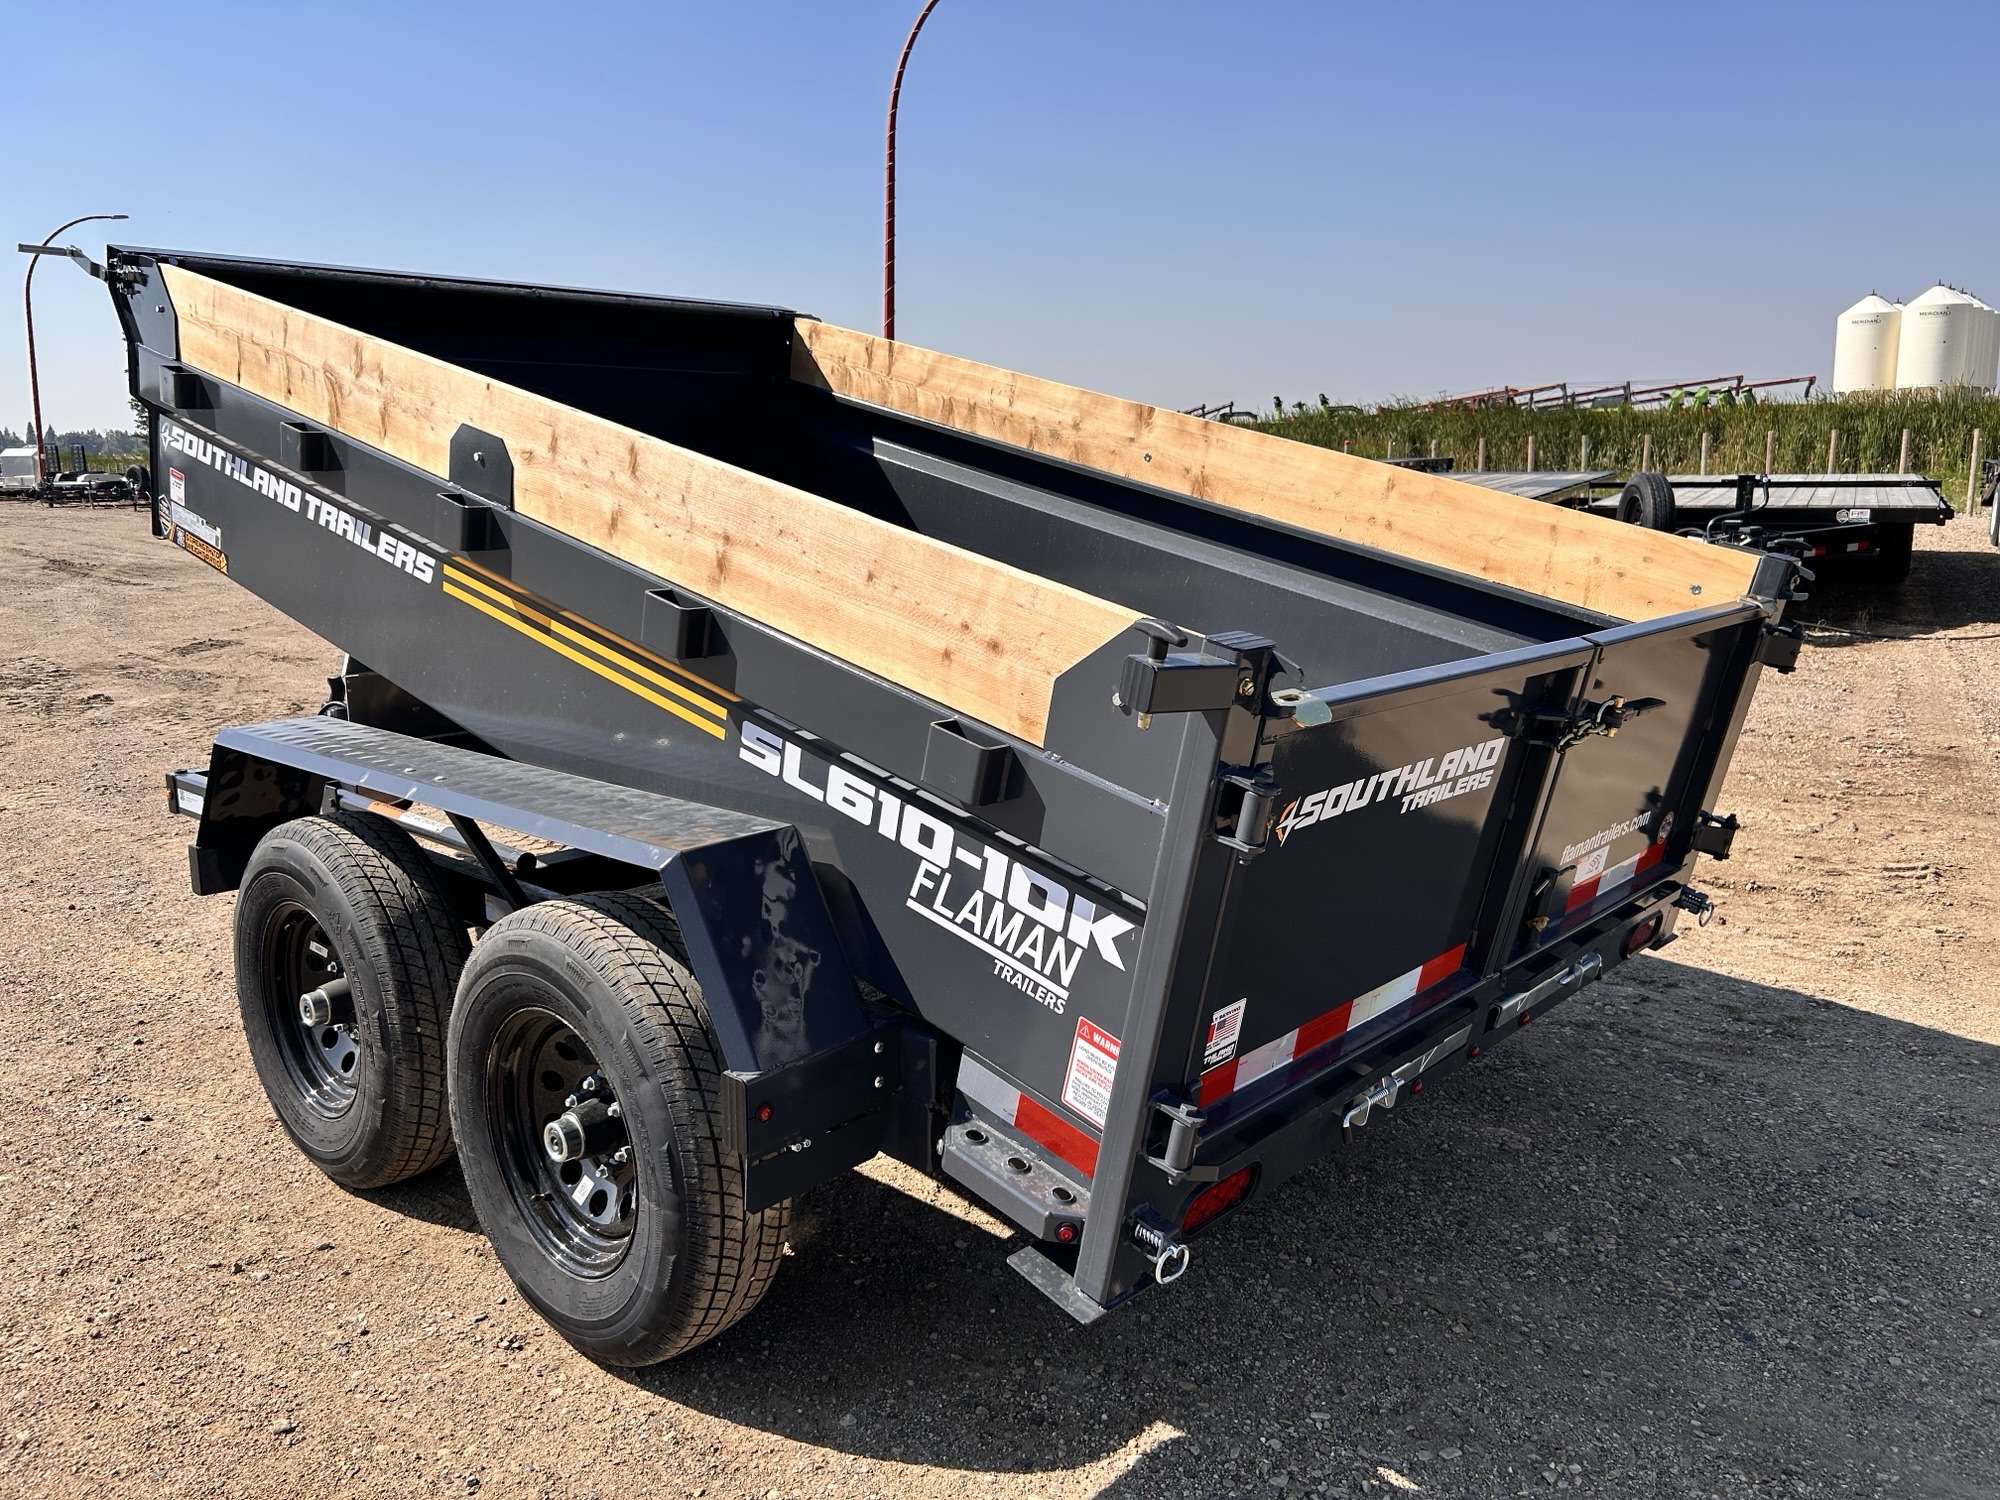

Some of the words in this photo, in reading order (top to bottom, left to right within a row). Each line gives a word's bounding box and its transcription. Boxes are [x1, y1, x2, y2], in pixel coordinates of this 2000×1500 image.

[169, 425, 301, 513] SOUTHLAND
[304, 492, 436, 584] TRAILERS
[1294, 737, 1506, 830] SOUTHLAND
[1400, 769, 1495, 815] TRAILERS
[739, 720, 1136, 972] SL610-10K
[1559, 810, 1652, 866] flamantrailers.com
[909, 859, 1084, 988] FLAMAN
[993, 959, 1067, 1015] TRAILERS
